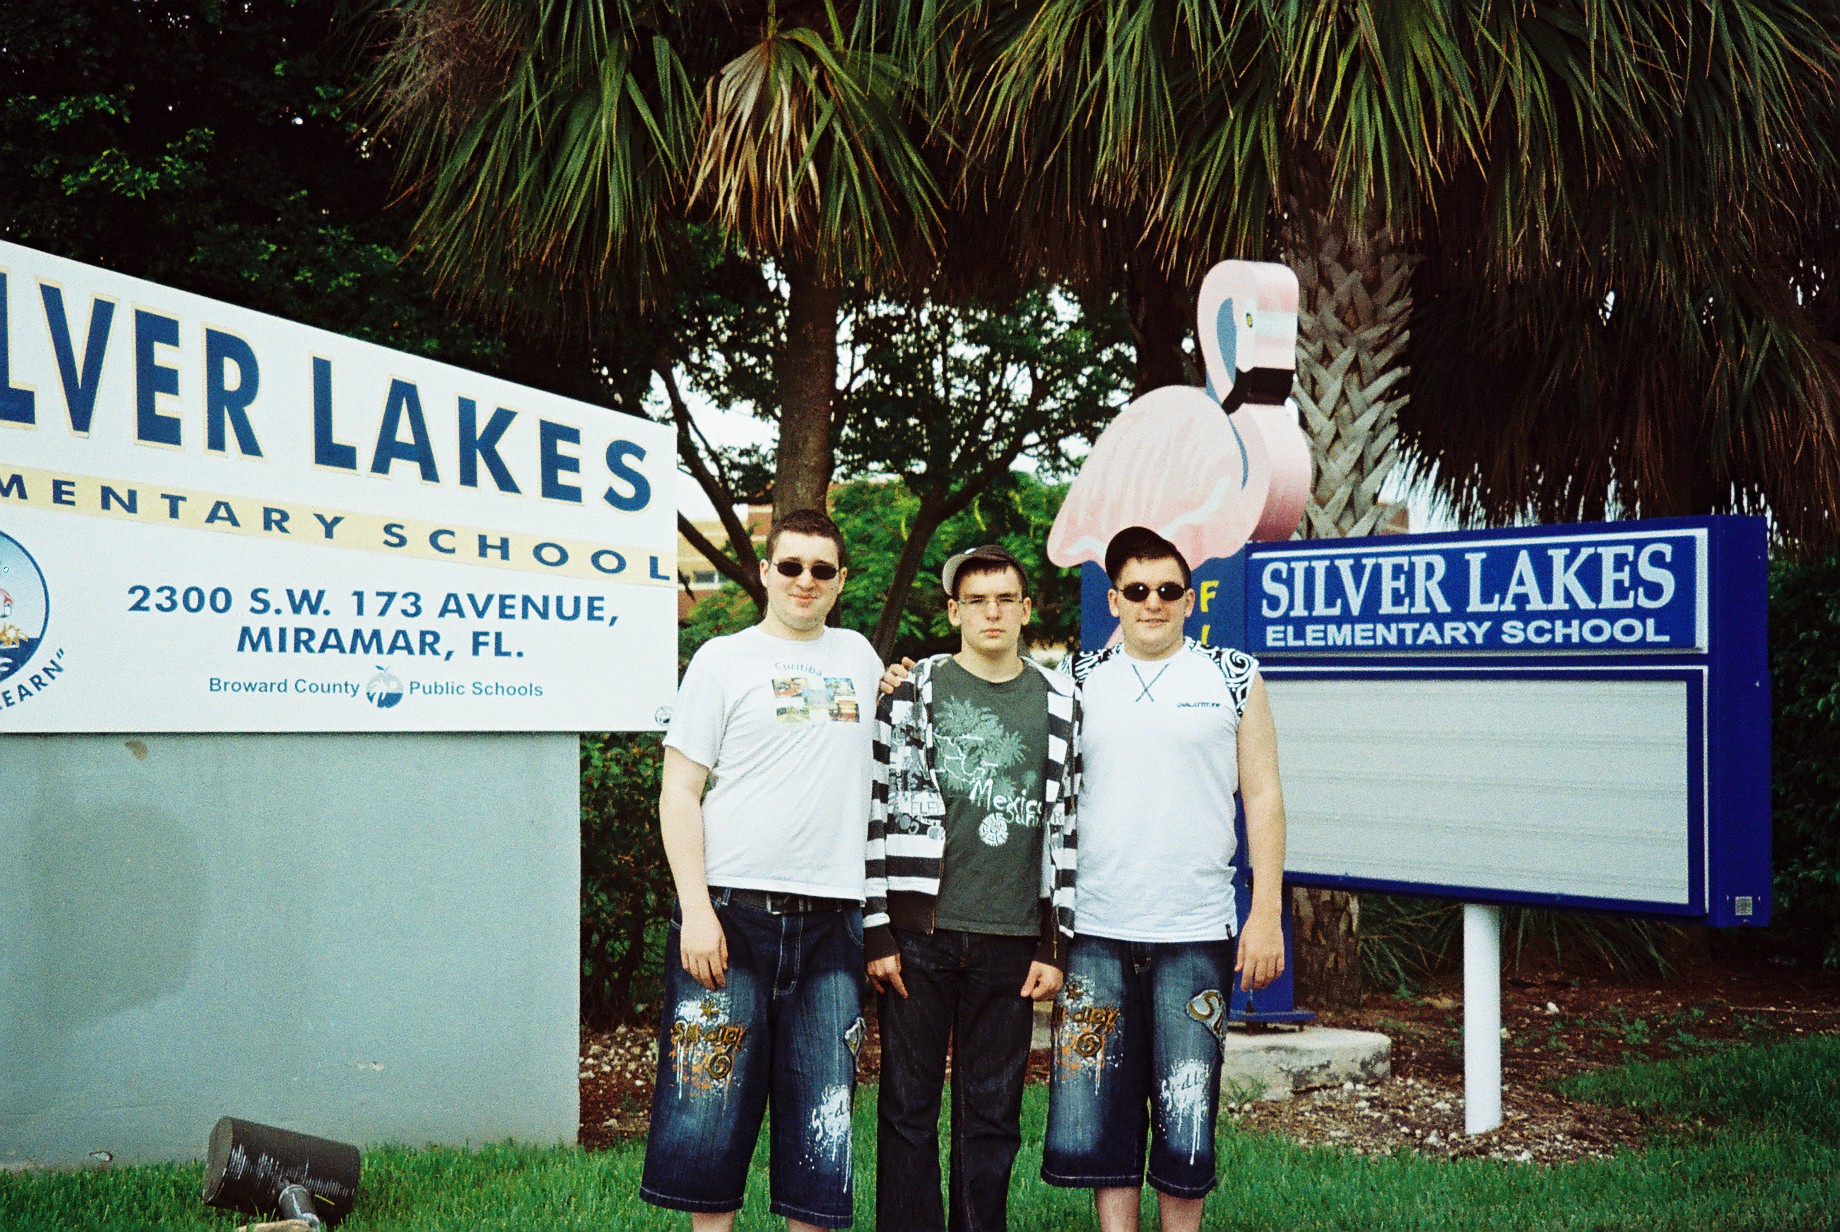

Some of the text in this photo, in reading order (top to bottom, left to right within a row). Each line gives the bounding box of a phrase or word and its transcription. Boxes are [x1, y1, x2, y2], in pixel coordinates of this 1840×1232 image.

[311, 355, 653, 513] LAKES
[383, 523, 671, 581] SCHOOL
[1261, 542, 1675, 618] SILVER LAKES
[127, 584, 620, 628] 2300 S.W. 173 AVENUE,
[236, 625, 525, 662] MIRAMAR, FL.
[1265, 617, 1670, 647] ELEMENTARY SCHOOL
[0, 647, 65, 710] EARN"
[209, 677, 544, 698] Broward County Public Schools
